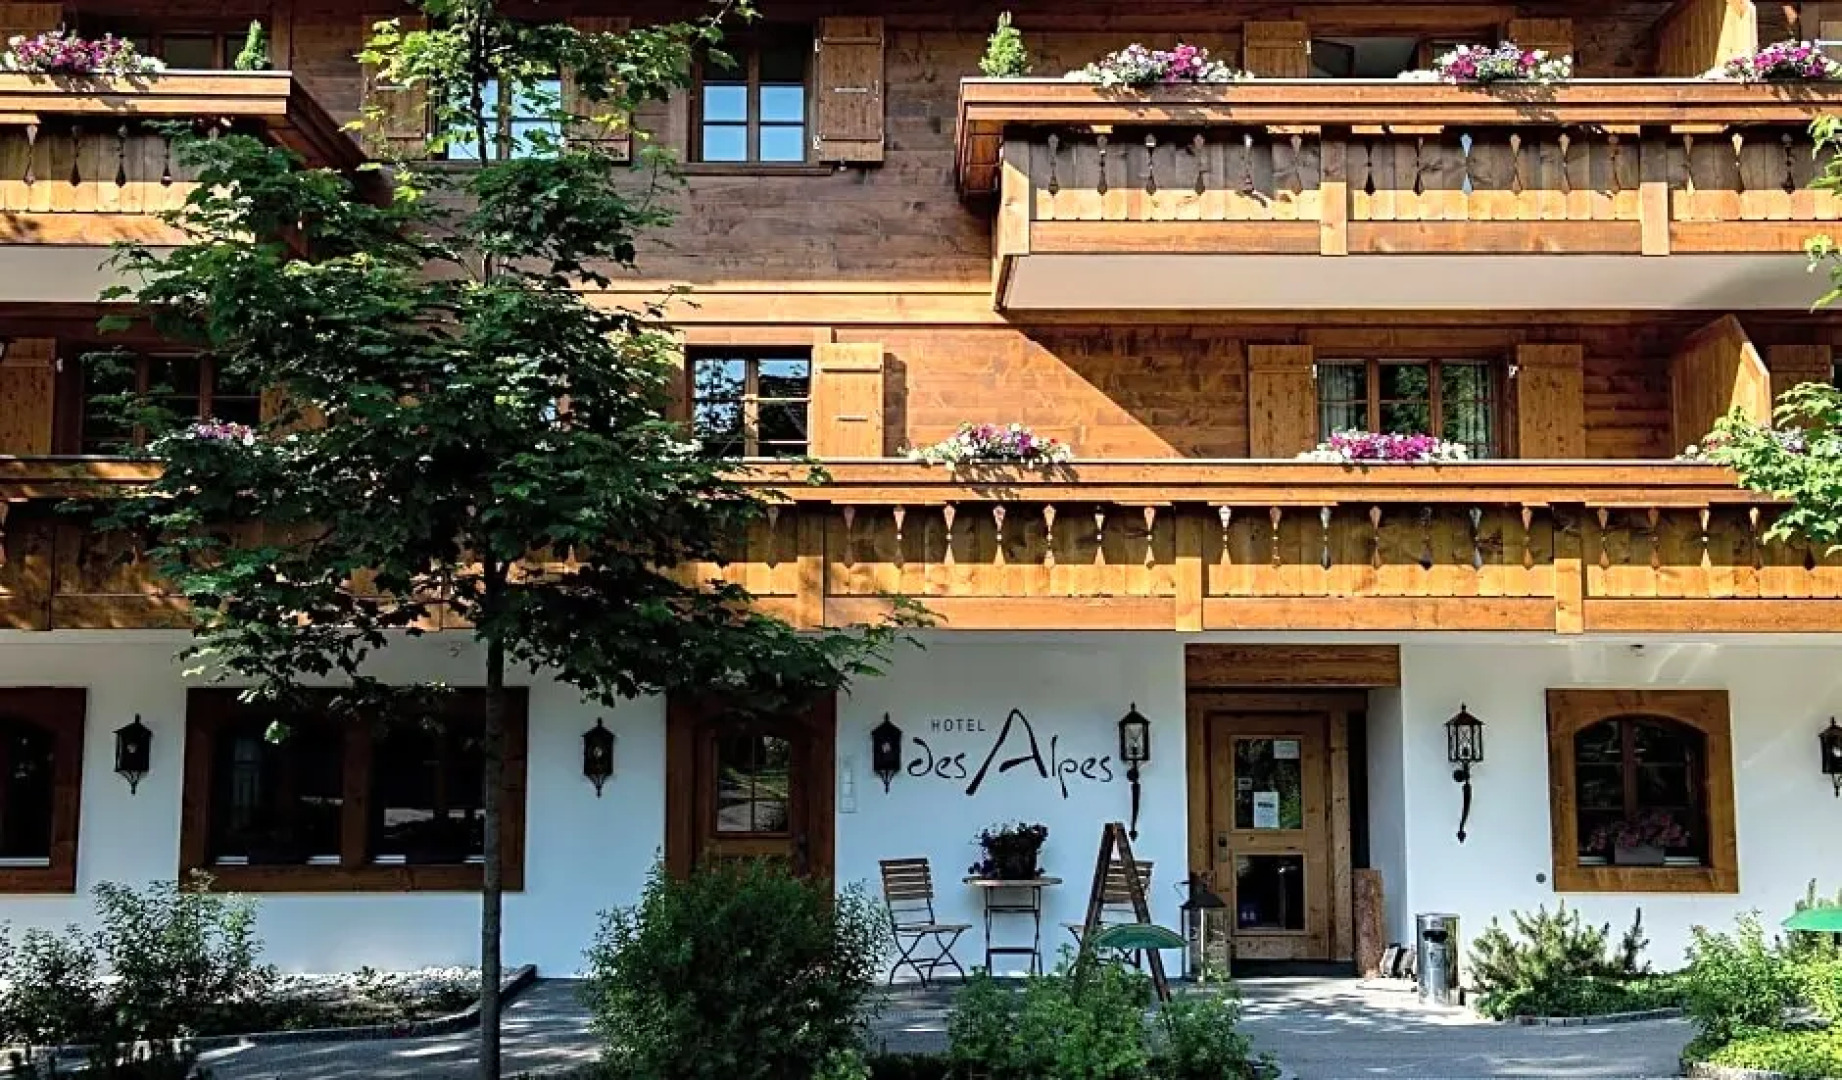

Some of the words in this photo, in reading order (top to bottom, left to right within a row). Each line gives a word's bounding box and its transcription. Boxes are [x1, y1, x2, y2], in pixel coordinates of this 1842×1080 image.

[931, 719, 985, 732] HOTEL
[907, 737, 966, 778] des
[966, 708, 1113, 799] Alpes
